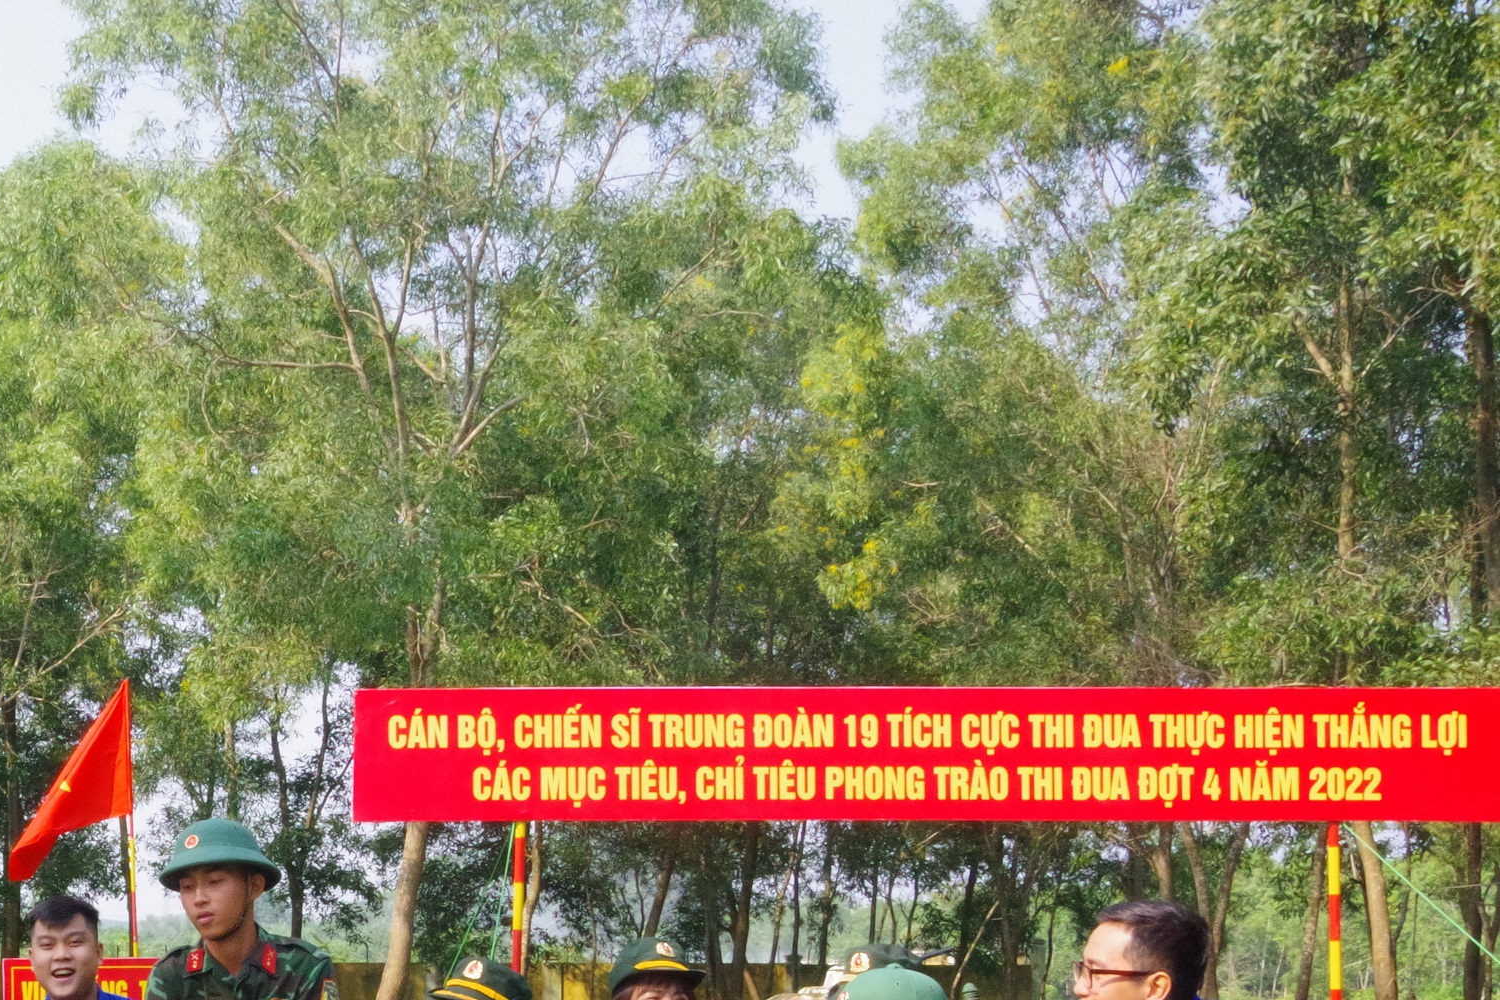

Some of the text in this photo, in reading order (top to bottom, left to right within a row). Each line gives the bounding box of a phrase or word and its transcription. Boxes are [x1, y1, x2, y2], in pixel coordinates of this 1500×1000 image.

[388, 701, 1467, 756] CÁN BỘ, CHIẾN SĨ TRUNG ĐOÀN 19 TÍCH CỰC THI ĐUA THỰC HIỆN THẮNG LỢI
[473, 755, 1381, 808] CÁC MỤC TIÊU, CHỈ TIÊU PHONG TRÀO THI ĐUA ĐỢT 4 NĂM 2022
